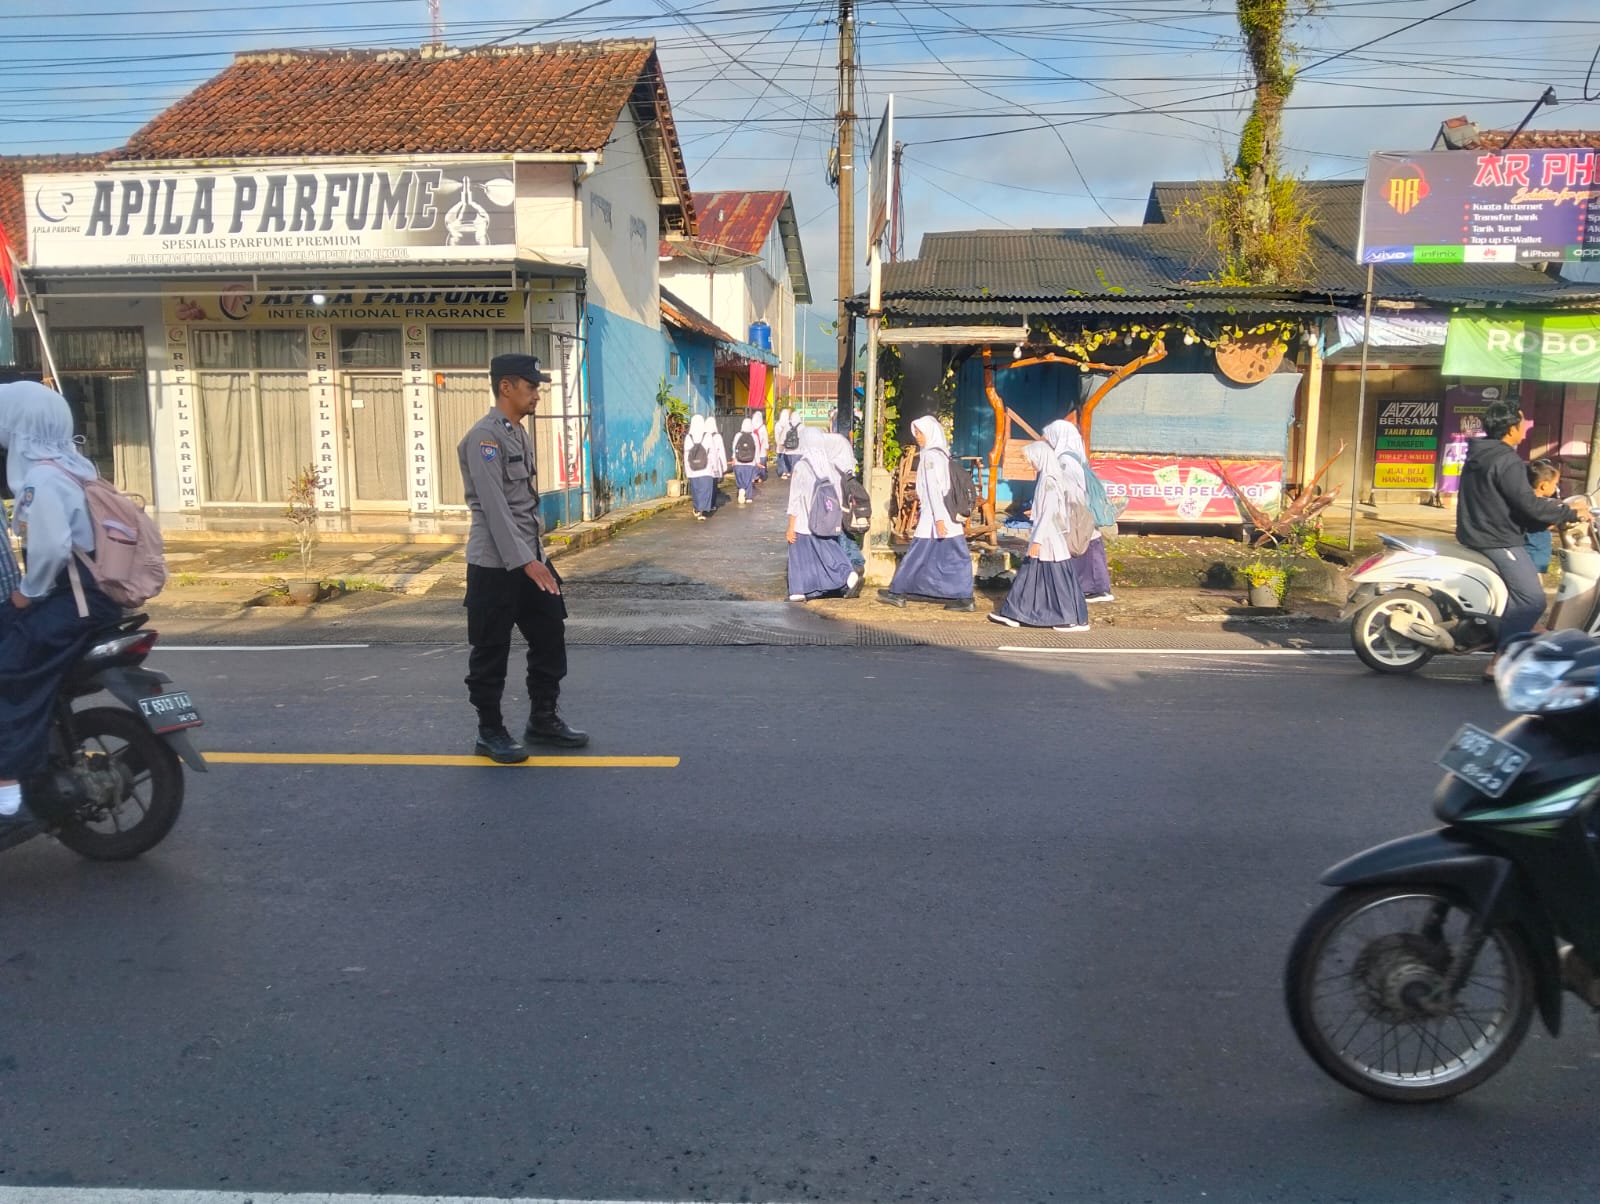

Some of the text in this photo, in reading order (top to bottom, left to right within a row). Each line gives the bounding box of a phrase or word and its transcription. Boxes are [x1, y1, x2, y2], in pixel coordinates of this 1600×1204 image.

[1473, 153, 1530, 187] AR
[84, 169, 443, 236] APILA PARFUME
[1504, 203, 1543, 211] Internet
[1473, 213, 1538, 221] Transfer bank
[1472, 225, 1522, 233] Tarik Tunai
[162, 235, 361, 250] SPESIALIS PARFUME PREMIUM
[1470, 236, 1542, 245] Top up E-Wallet
[1370, 250, 1406, 260] vivo
[1420, 249, 1457, 258] infinix
[1529, 249, 1560, 258] iPhone
[362, 285, 509, 305] PARFUME
[268, 308, 506, 319] INTERNATIONAL FRAGRANCE
[173, 352, 188, 420] REFILL
[316, 351, 330, 420] REFILL
[410, 351, 423, 421] REFILL
[1381, 402, 1439, 418] ATM
[1379, 417, 1438, 425] BERSAMA
[179, 429, 195, 507] PARFUME
[414, 430, 428, 511] PARFUME
[1131, 485, 1184, 496] TELER
[1189, 485, 1263, 497] PELAGI
